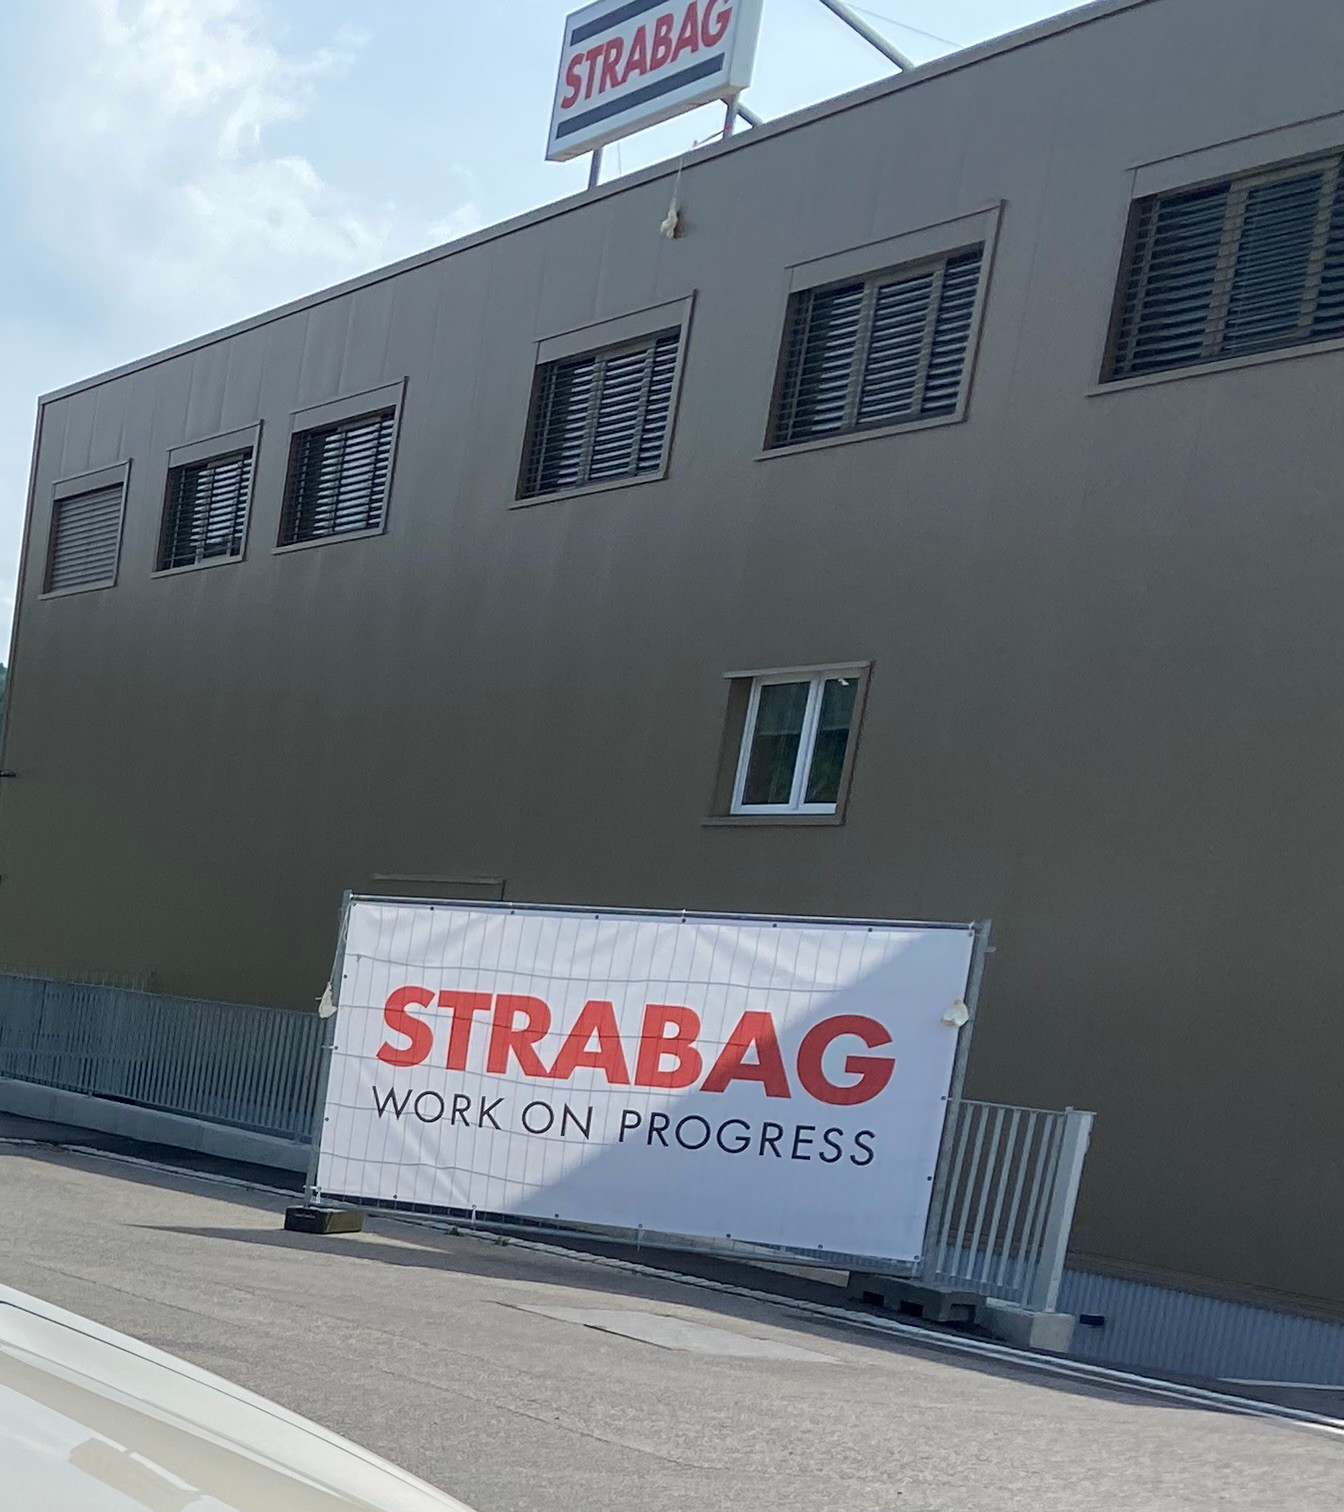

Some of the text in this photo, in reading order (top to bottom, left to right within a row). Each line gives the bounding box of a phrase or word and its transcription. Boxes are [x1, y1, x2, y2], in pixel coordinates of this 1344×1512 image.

[561, 0, 733, 109] STRABAG
[376, 985, 896, 1106] STRABAG
[372, 1085, 876, 1166] WORK ON PROGRESS
